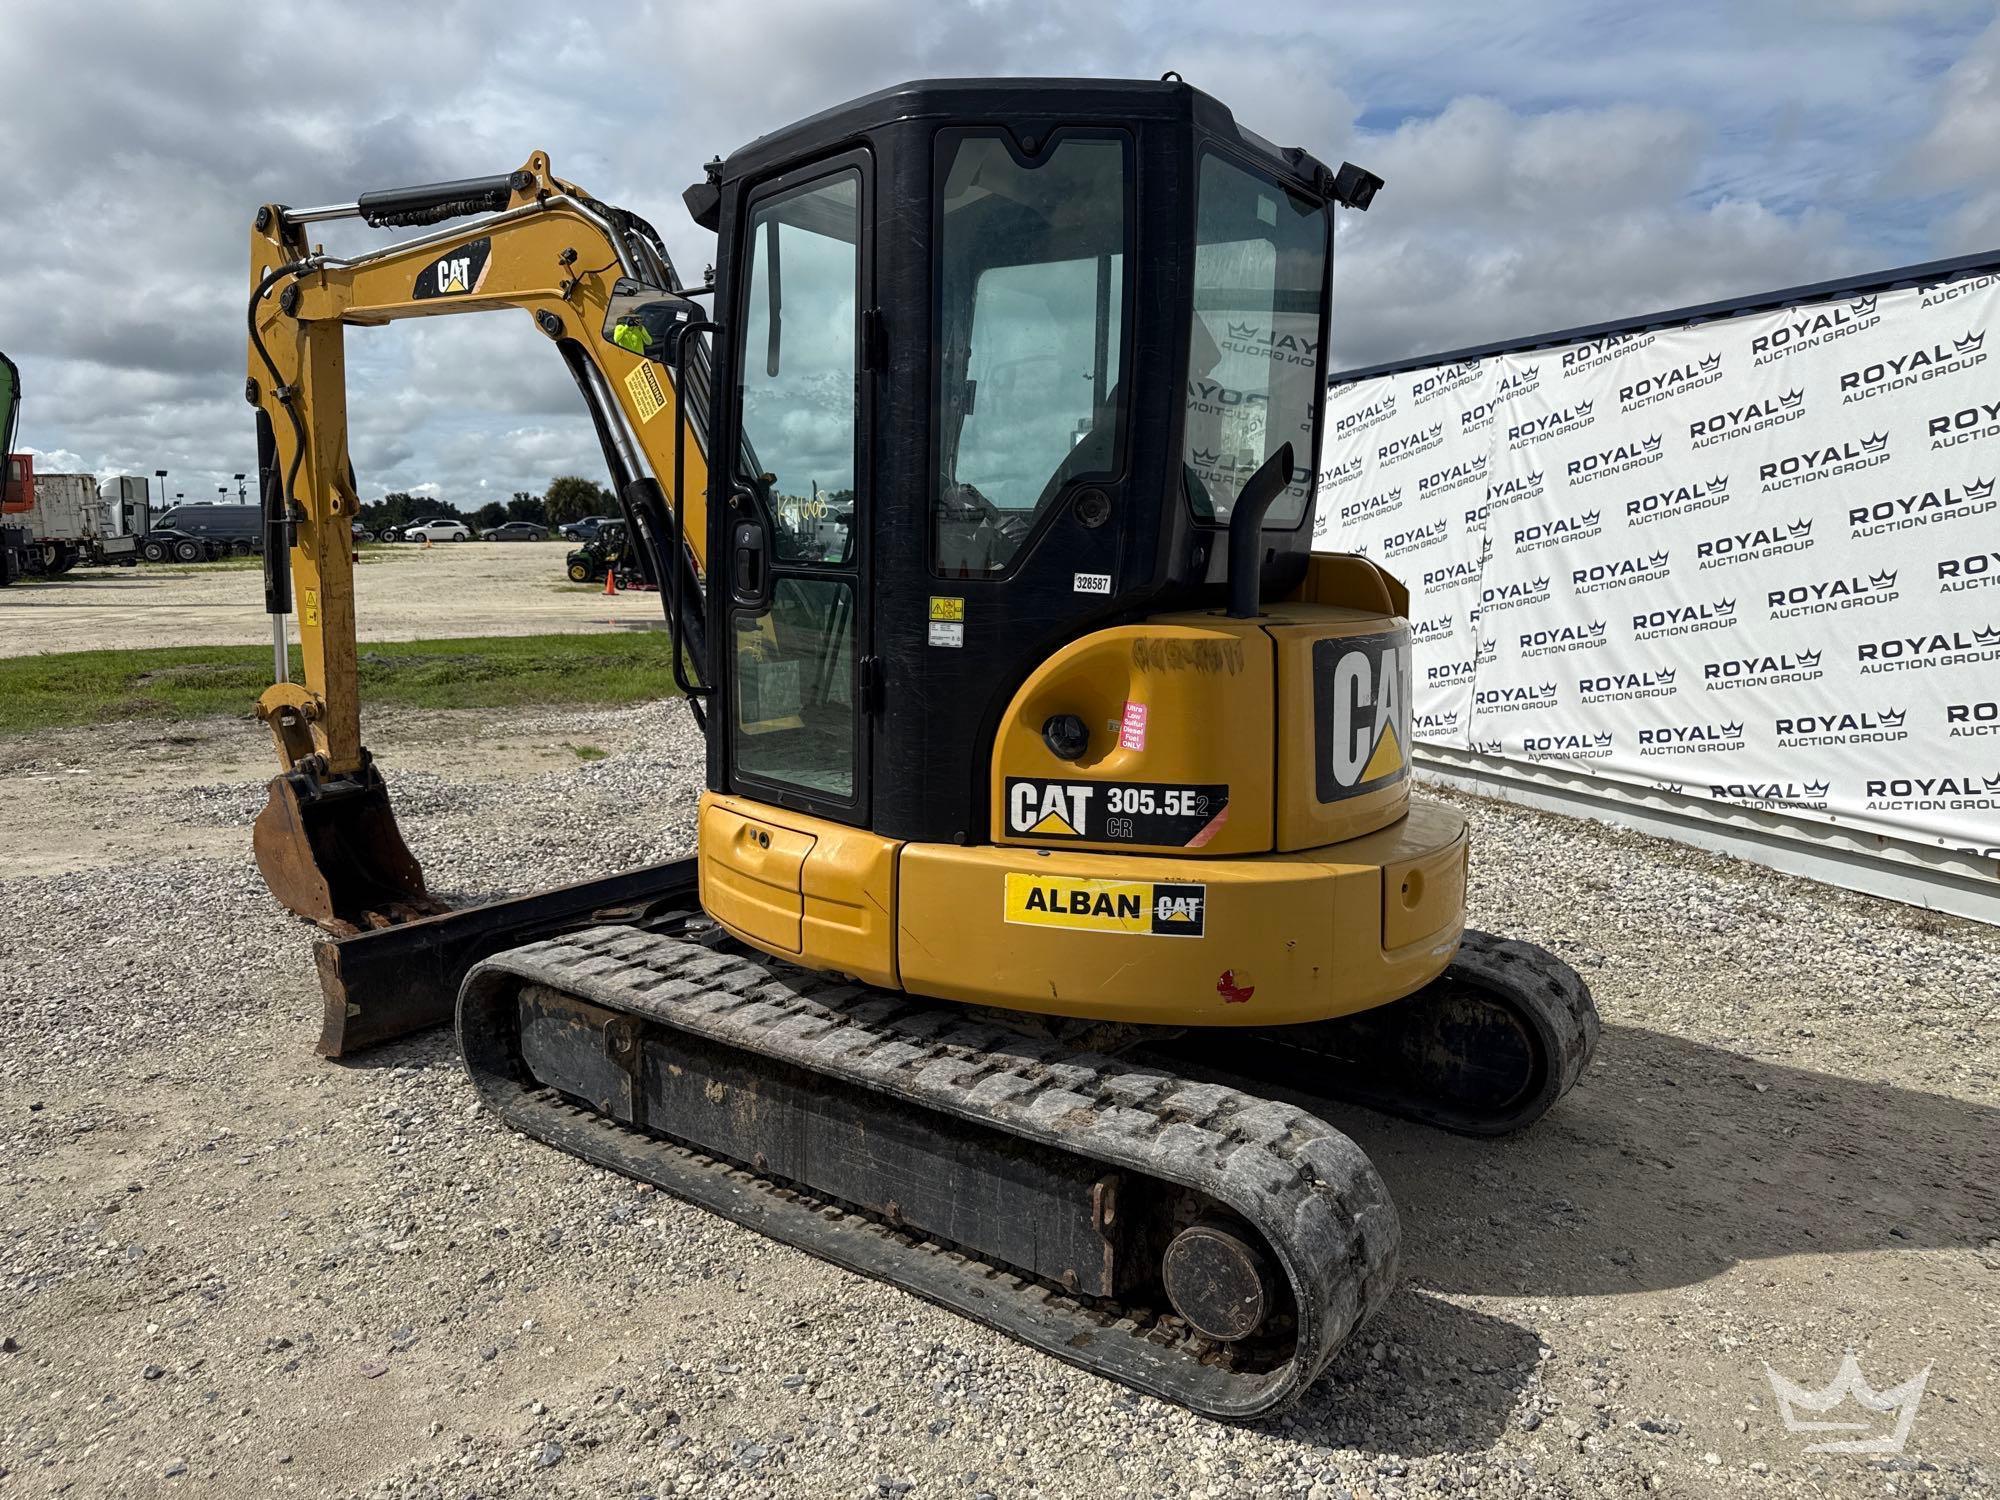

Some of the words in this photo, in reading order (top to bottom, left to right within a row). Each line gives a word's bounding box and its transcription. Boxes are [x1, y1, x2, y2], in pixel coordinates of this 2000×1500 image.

[438, 258, 470, 293] CAT
[1752, 309, 1850, 355] ROYAL
[1754, 337, 1820, 367] AUCTION
[1823, 316, 1880, 343] GROUP
[1563, 353, 1612, 379] AUCTION
[1614, 336, 1655, 358] GROUP
[1840, 345, 1953, 392] ROYAL
[643, 363, 664, 406] WARNING
[1413, 365, 1466, 398] ROYAL
[1415, 385, 1451, 406] AUCTION
[1452, 371, 1483, 390] GROUP
[1506, 382, 1539, 400] GROUP
[1619, 364, 1699, 403] ROYAL
[1842, 374, 1917, 405] AUCTION
[1921, 353, 1987, 381] GROUP
[1621, 388, 1674, 414] AUCTION
[1677, 372, 1723, 394] GROUP
[1336, 403, 1383, 433] ROYAL
[1461, 399, 1497, 425] ROY
[1690, 399, 1779, 439] ROYAL
[1928, 401, 2000, 437] ROY
[1338, 422, 1369, 441] AUCTION
[1370, 409, 1397, 426] GROUP
[1463, 416, 1494, 435] AUCTIO
[1508, 409, 1575, 441] ROYAL
[1509, 430, 1554, 451] AUCTION
[1556, 416, 1595, 436] GROUP
[1692, 425, 1751, 450] AUCTION
[1754, 408, 1805, 431] GROUP
[1931, 424, 2000, 451] AUCTIO
[1378, 430, 1429, 460] ROYAL
[1380, 450, 1414, 469] AUCTION
[1415, 437, 1443, 454] GROUP
[1567, 443, 1642, 476] ROYAL
[1569, 465, 1620, 487] AUCTION
[1622, 452, 1663, 471] GROUP
[1760, 443, 1860, 481] ROYAL
[1318, 463, 1350, 485] OYAL
[1338, 470, 1362, 485] GROUP
[1419, 463, 1472, 491] ROYAL
[1420, 482, 1456, 501] AUCTION
[1457, 470, 1487, 487] GROUP
[1761, 469, 1829, 493] AUCTION
[1832, 453, 1890, 476] GROUP
[1487, 478, 1527, 501] YAL
[1487, 498, 1509, 511] TION
[1510, 487, 1544, 504] GROUP
[1626, 484, 1706, 516] ROYAL
[1341, 494, 1389, 519] ROYAL
[1342, 512, 1374, 527] AUCTION
[1376, 501, 1403, 516] GROUP
[1628, 507, 1681, 527] AUCTION
[1684, 494, 1730, 513] GROUP
[1849, 488, 1963, 526] ROYAL
[1313, 528, 1328, 538] OUP
[1514, 517, 1581, 544] ROYAL
[1851, 515, 1927, 540] AUCTION
[1931, 501, 1997, 523] GROUP
[1384, 525, 1434, 550] ROYAL
[1385, 543, 1419, 559] AUCTION
[1421, 534, 1448, 548] GROUP
[1515, 537, 1559, 555] AUCTION
[1561, 527, 1602, 543] GROUP
[1697, 527, 1787, 559] ROYAL
[1699, 550, 1759, 570] AUCTION
[1762, 539, 1814, 557] GROUP
[1077, 576, 1108, 591] 328587
[1424, 561, 1476, 585] ROYAL
[1573, 557, 1649, 585] ROYAL
[1575, 578, 1626, 595] AUCTION
[1628, 569, 1670, 585] GROUP
[1425, 580, 1460, 595] AUCTION
[1461, 574, 1480, 585] GRO
[1482, 582, 1533, 602] OYAL
[1768, 577, 1869, 608] ROYAL
[1940, 574, 2000, 594] AUCTI
[1516, 593, 1550, 607] GROUP
[1770, 601, 1837, 620] AUCTION
[1841, 592, 1899, 609] GROUP
[1410, 620, 1438, 635] YAL
[1633, 604, 1713, 630] ROYAL
[1634, 625, 1688, 641] AUCTION
[1691, 618, 1737, 632] GROUP
[1425, 630, 1453, 643] GROUP
[1520, 626, 1588, 648] ROYAL
[1521, 644, 1566, 658] AUCTION
[1568, 638, 1607, 651] GROUP
[1858, 632, 1972, 661] ROYAL
[1704, 655, 1796, 679] ROYAL
[1860, 657, 1936, 675] AUCTION
[1429, 677, 1466, 688] AUCTION
[1579, 672, 1655, 693] ROYAL
[1706, 677, 1767, 691] AUCTION
[1770, 670, 1823, 684] GROUP
[1127, 703, 1143, 713] Ultra
[1475, 686, 1539, 705] ROYAL
[1476, 704, 1520, 714] AUCTION
[1521, 700, 1558, 710] GROUP
[1581, 692, 1633, 704] AUCTION
[1634, 687, 1677, 699] GROUP
[1124, 718, 1144, 728] Sulfur
[1127, 712, 1141, 720] Low
[1413, 714, 1443, 728] YAL
[1776, 713, 1877, 735] ROYAL
[1123, 725, 1144, 735] Diesel
[1125, 733, 1140, 742] Fuel
[1429, 727, 1458, 736] GROUP
[1639, 725, 1720, 744] ROYAL
[1778, 735, 1846, 748] AUCTION
[1849, 731, 1908, 743] GROUP
[1949, 724, 2000, 738] AUCT
[1122, 740, 1141, 750] ONLY
[1523, 735, 1593, 751] ROYAL
[1528, 752, 1571, 761] AUCTION
[1572, 750, 1613, 760] GROUP
[1640, 745, 1695, 756] AUCTION
[1697, 742, 1745, 752] GROUP
[1709, 783, 1801, 798] ROYAL
[1866, 777, 1982, 797] ROYAL
[1010, 782, 1094, 836] CAT
[1866, 800, 1946, 810] AUCTION
[1950, 799, 2000, 810] GROU
[1106, 817, 1133, 838] CR
[1024, 887, 1141, 919] ALBAN
[1158, 896, 1203, 922] CAT
